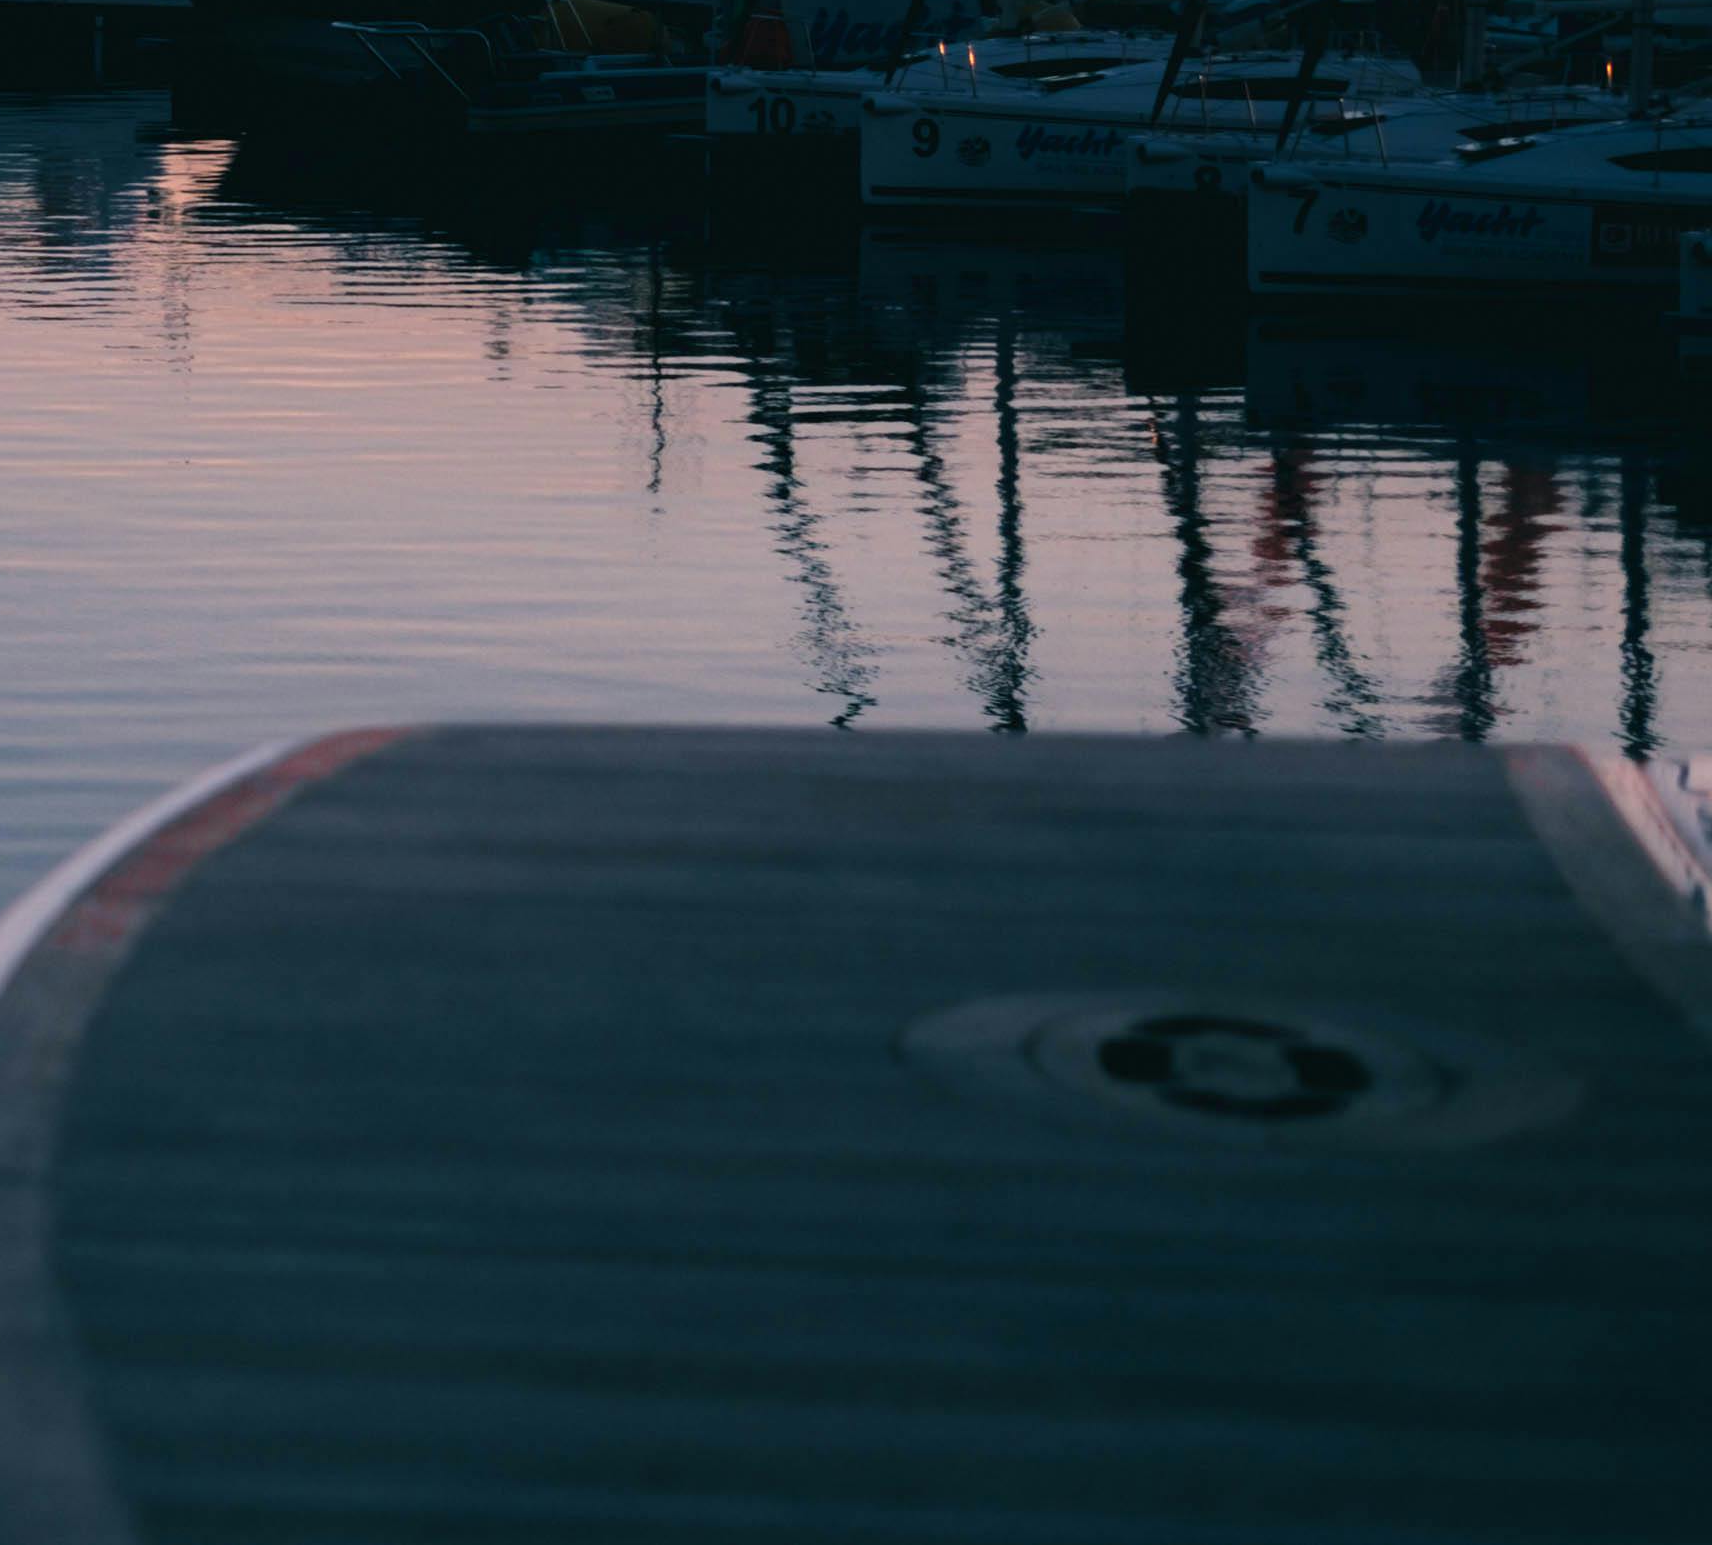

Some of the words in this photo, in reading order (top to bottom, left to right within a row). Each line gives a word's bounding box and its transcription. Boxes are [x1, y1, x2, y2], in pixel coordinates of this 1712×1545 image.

[748, 97, 796, 135] 10
[912, 118, 940, 158] 9
[1015, 123, 1126, 161] Yacht
[1288, 186, 1320, 235] 7
[1415, 198, 1548, 243] Yacht
